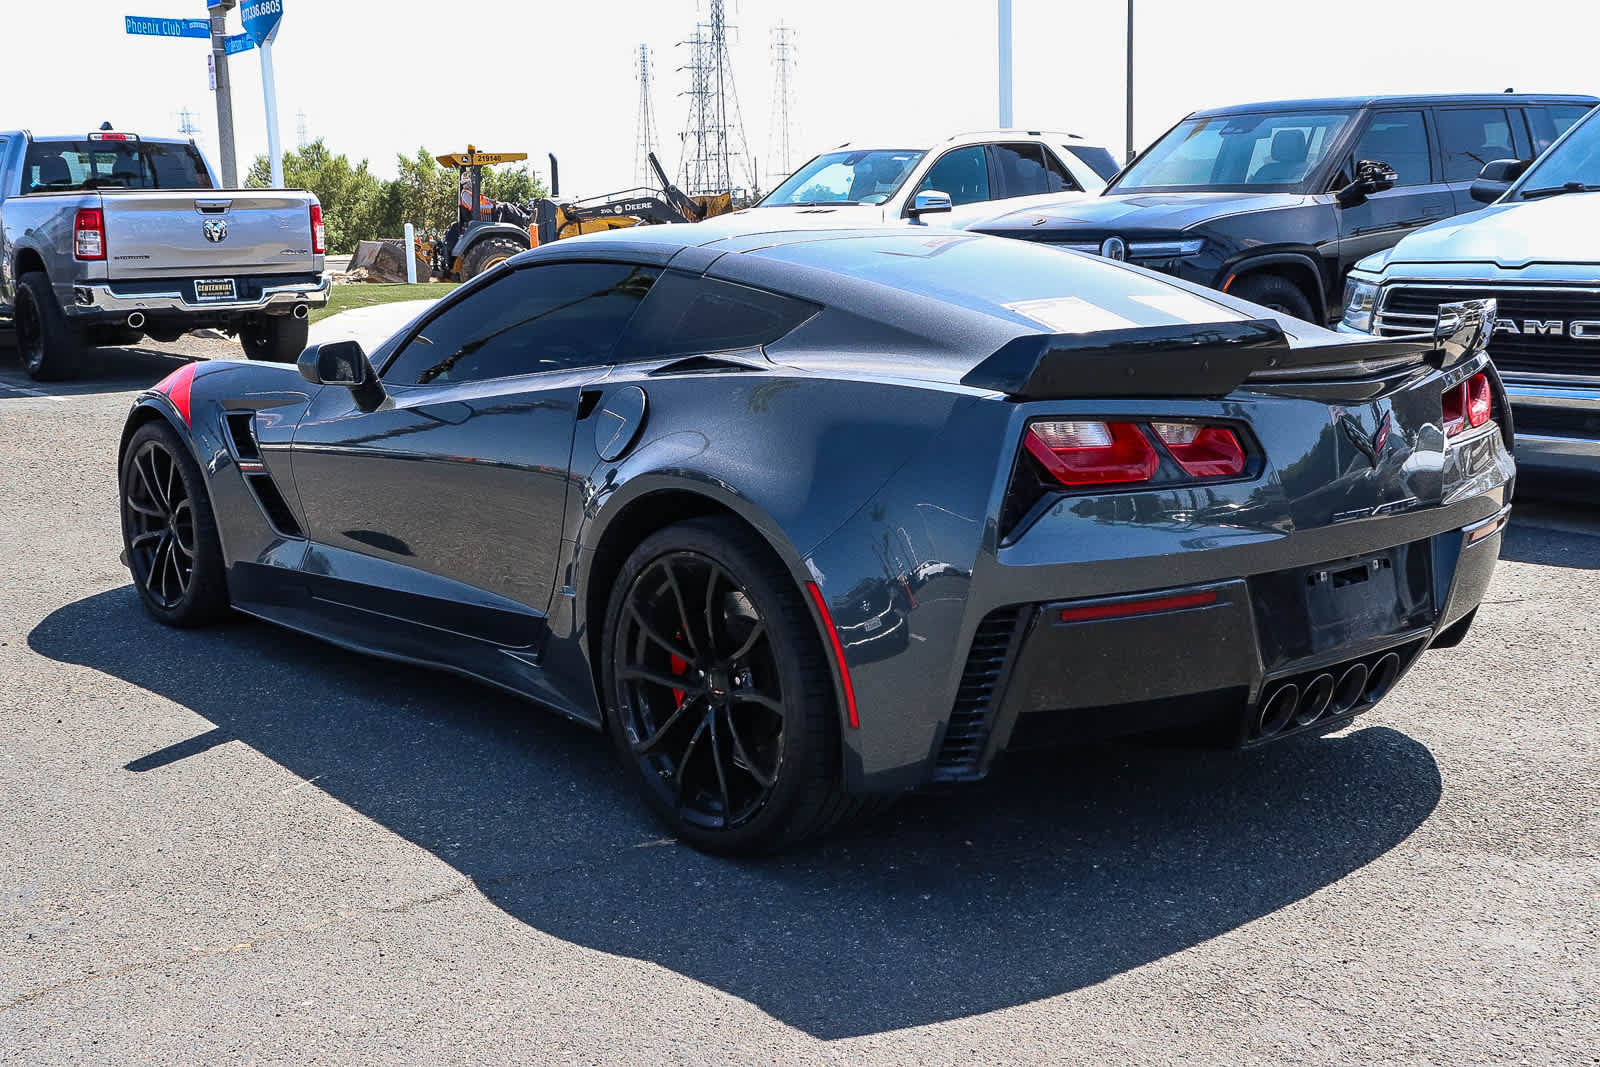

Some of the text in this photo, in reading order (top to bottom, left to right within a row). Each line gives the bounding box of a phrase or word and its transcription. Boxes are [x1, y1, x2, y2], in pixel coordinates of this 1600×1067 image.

[127, 18, 160, 34] Phoenix
[162, 20, 180, 36] Club
[625, 202, 652, 211] DEERE
[1495, 319, 1563, 335] AM
